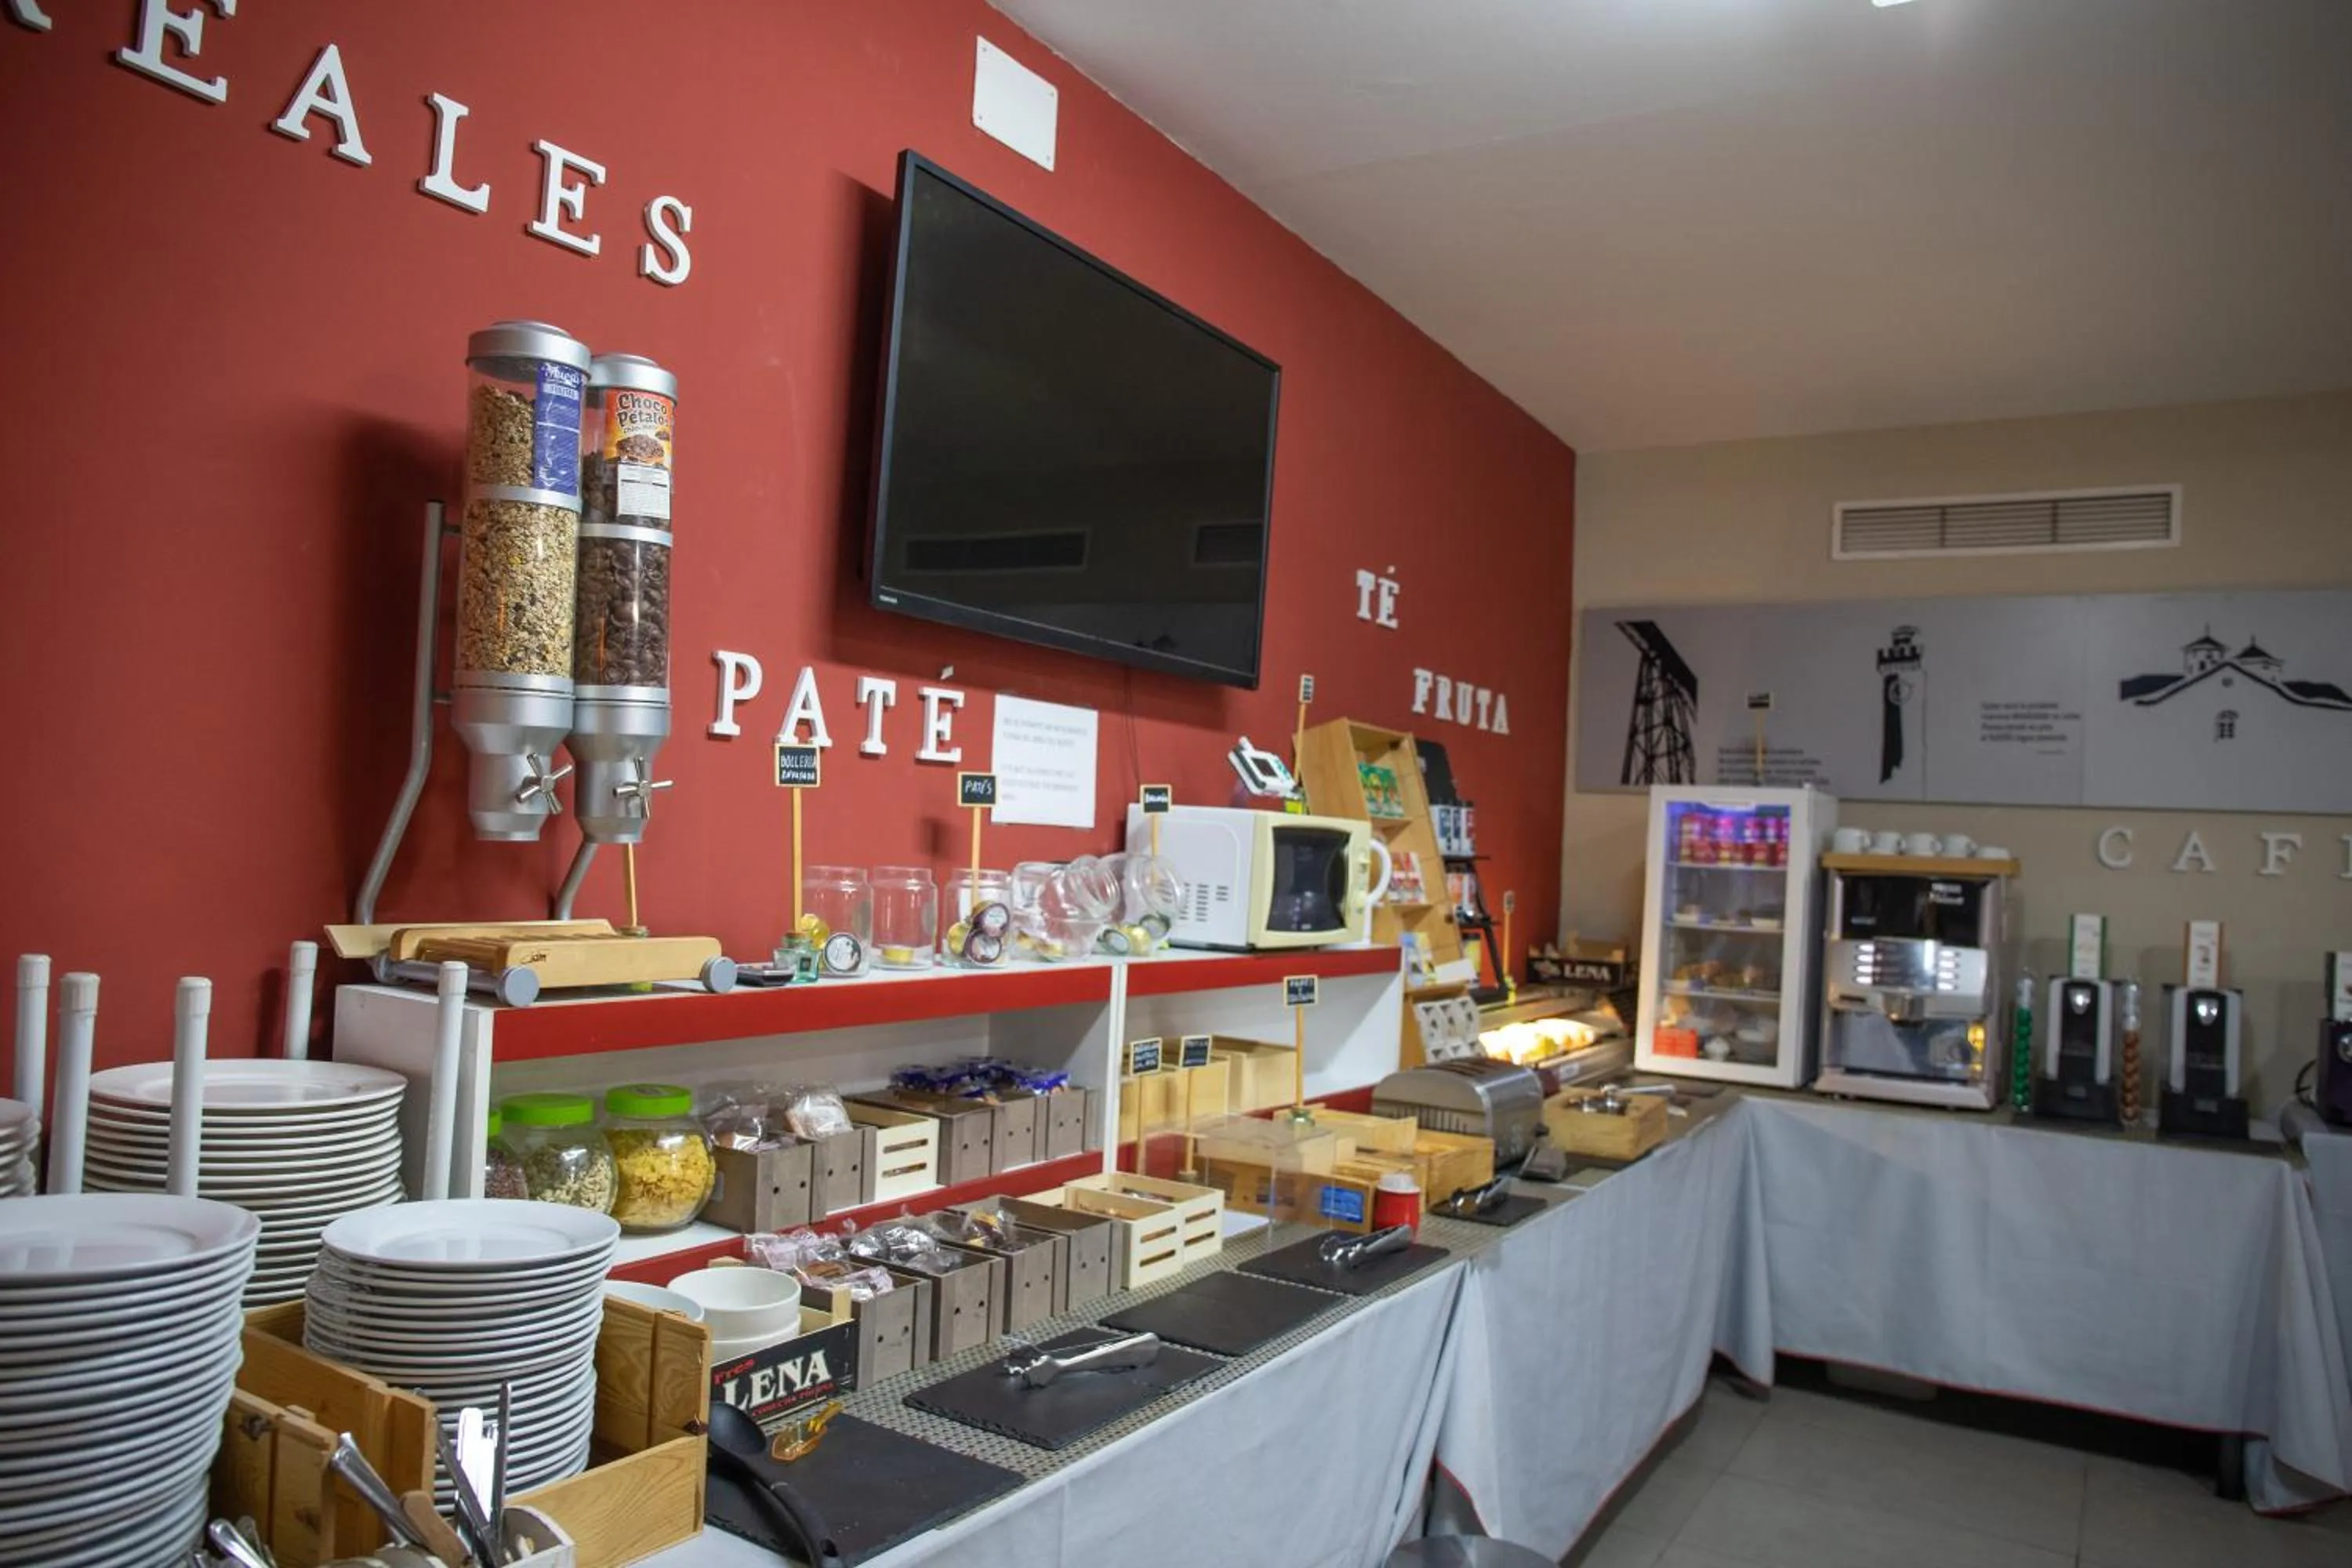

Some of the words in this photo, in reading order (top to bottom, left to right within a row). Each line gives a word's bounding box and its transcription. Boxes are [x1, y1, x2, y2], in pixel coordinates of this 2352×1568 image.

[6, 0, 692, 286] EALES
[618, 393, 667, 414] Choco
[1356, 565, 1400, 629] TÉ
[709, 650, 965, 763] PATÉ
[1412, 668, 1510, 735] FRUTA
[2097, 827, 2352, 880] CAF
[722, 1348, 833, 1411] LENA
